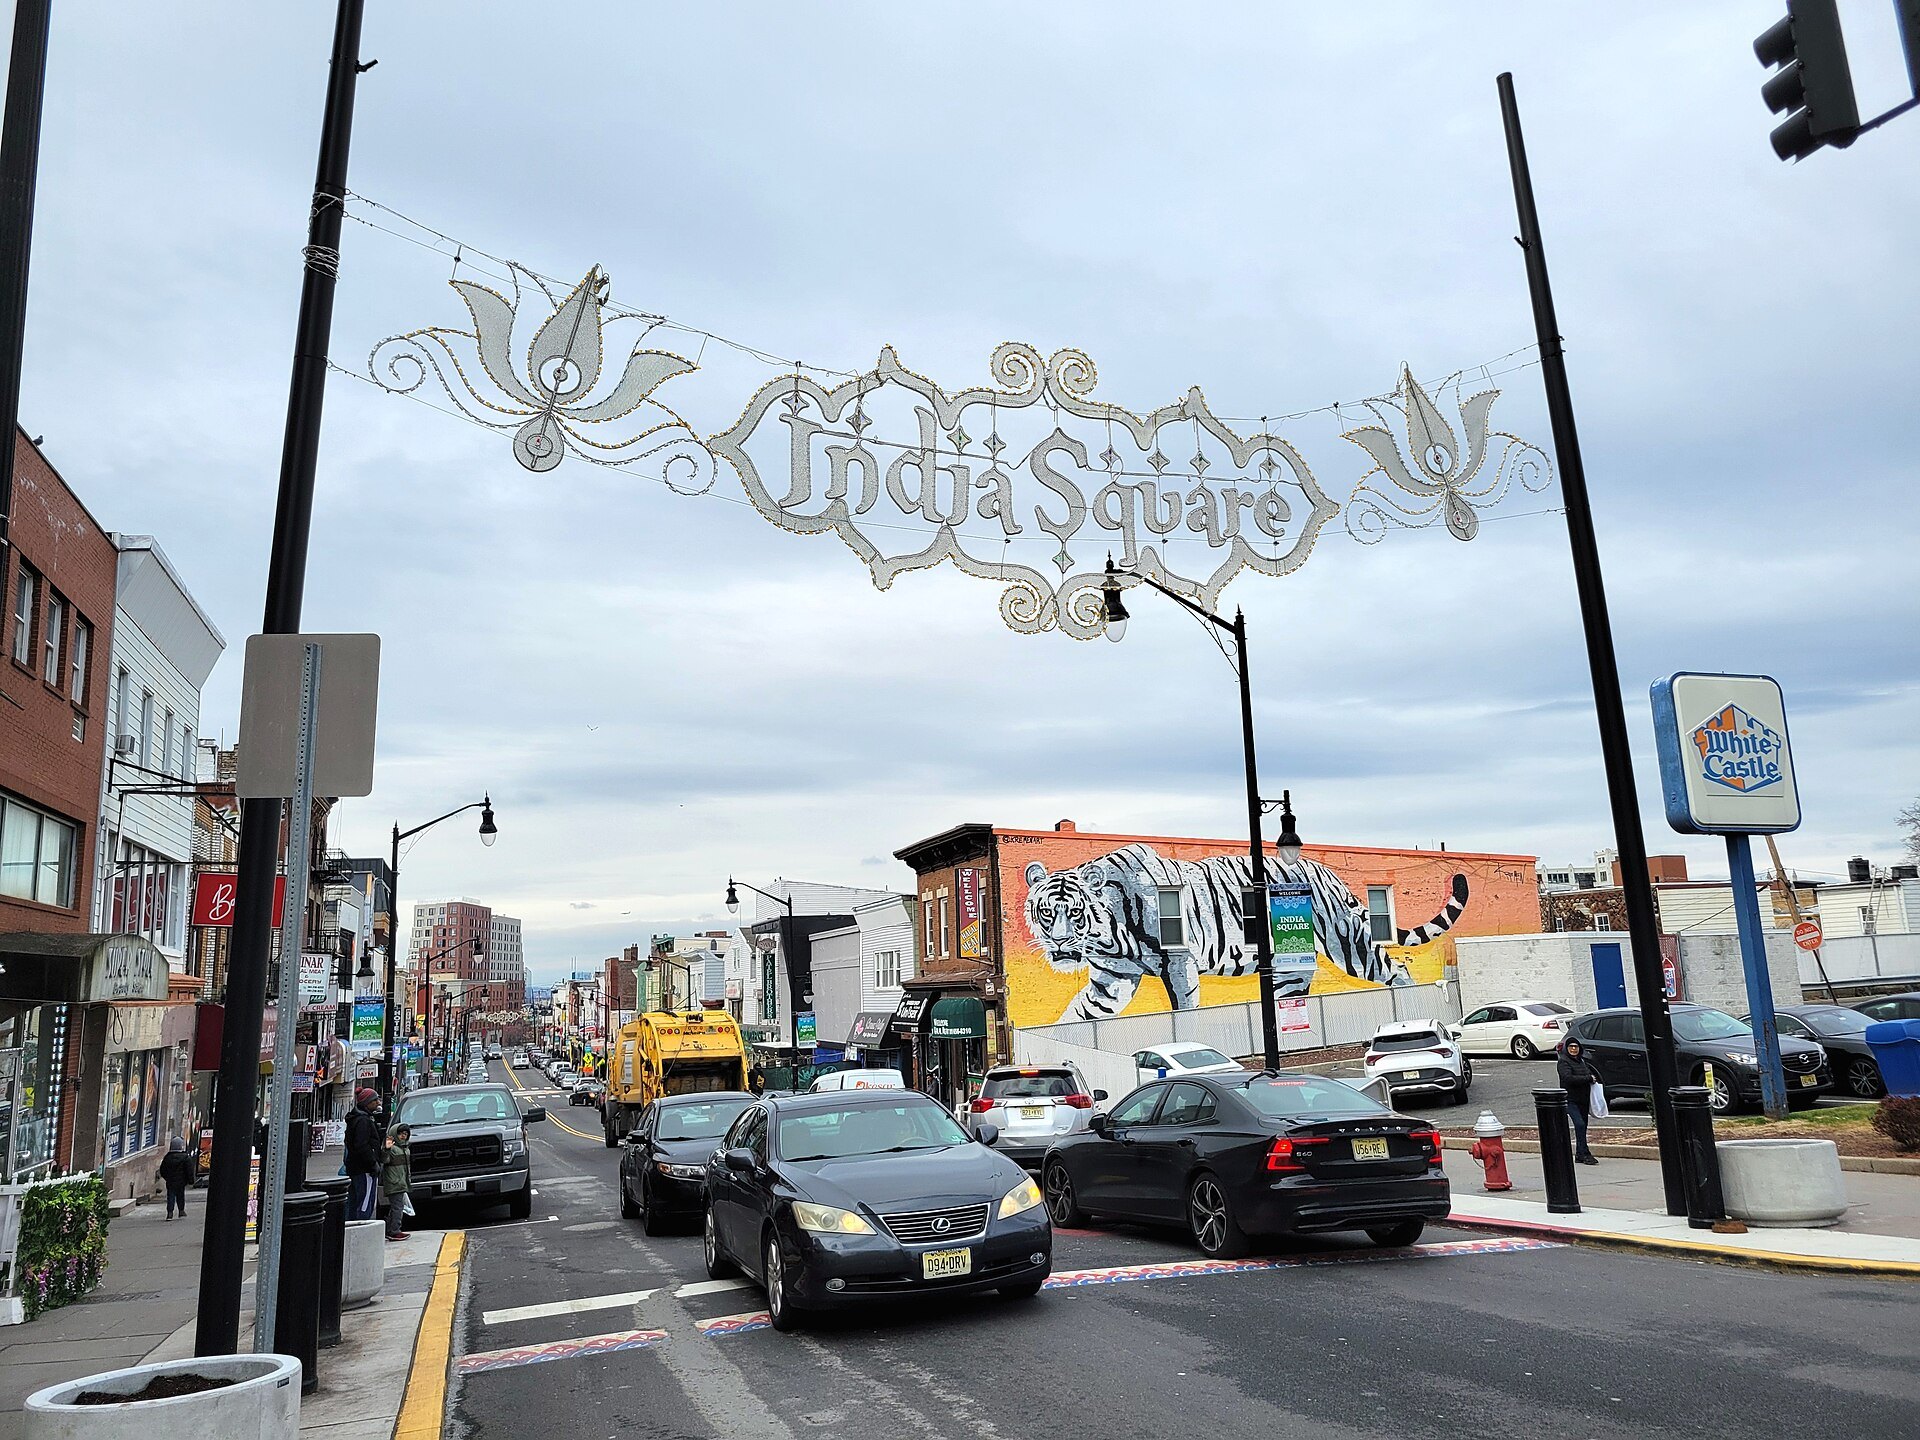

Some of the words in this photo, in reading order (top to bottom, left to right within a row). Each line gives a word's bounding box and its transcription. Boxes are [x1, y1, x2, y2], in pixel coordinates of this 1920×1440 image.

[779, 406, 1022, 536] India
[1029, 426, 1291, 568] Square
[1705, 730, 1772, 758] White
[1704, 754, 1779, 779] Castle
[1276, 922, 1310, 931] SQUARE
[1280, 915, 1305, 923] INDIA
[961, 924, 979, 939] HALAL
[962, 936, 979, 953] MEAT
[301, 956, 324, 968] INAR
[305, 1047, 315, 1071] ATM
